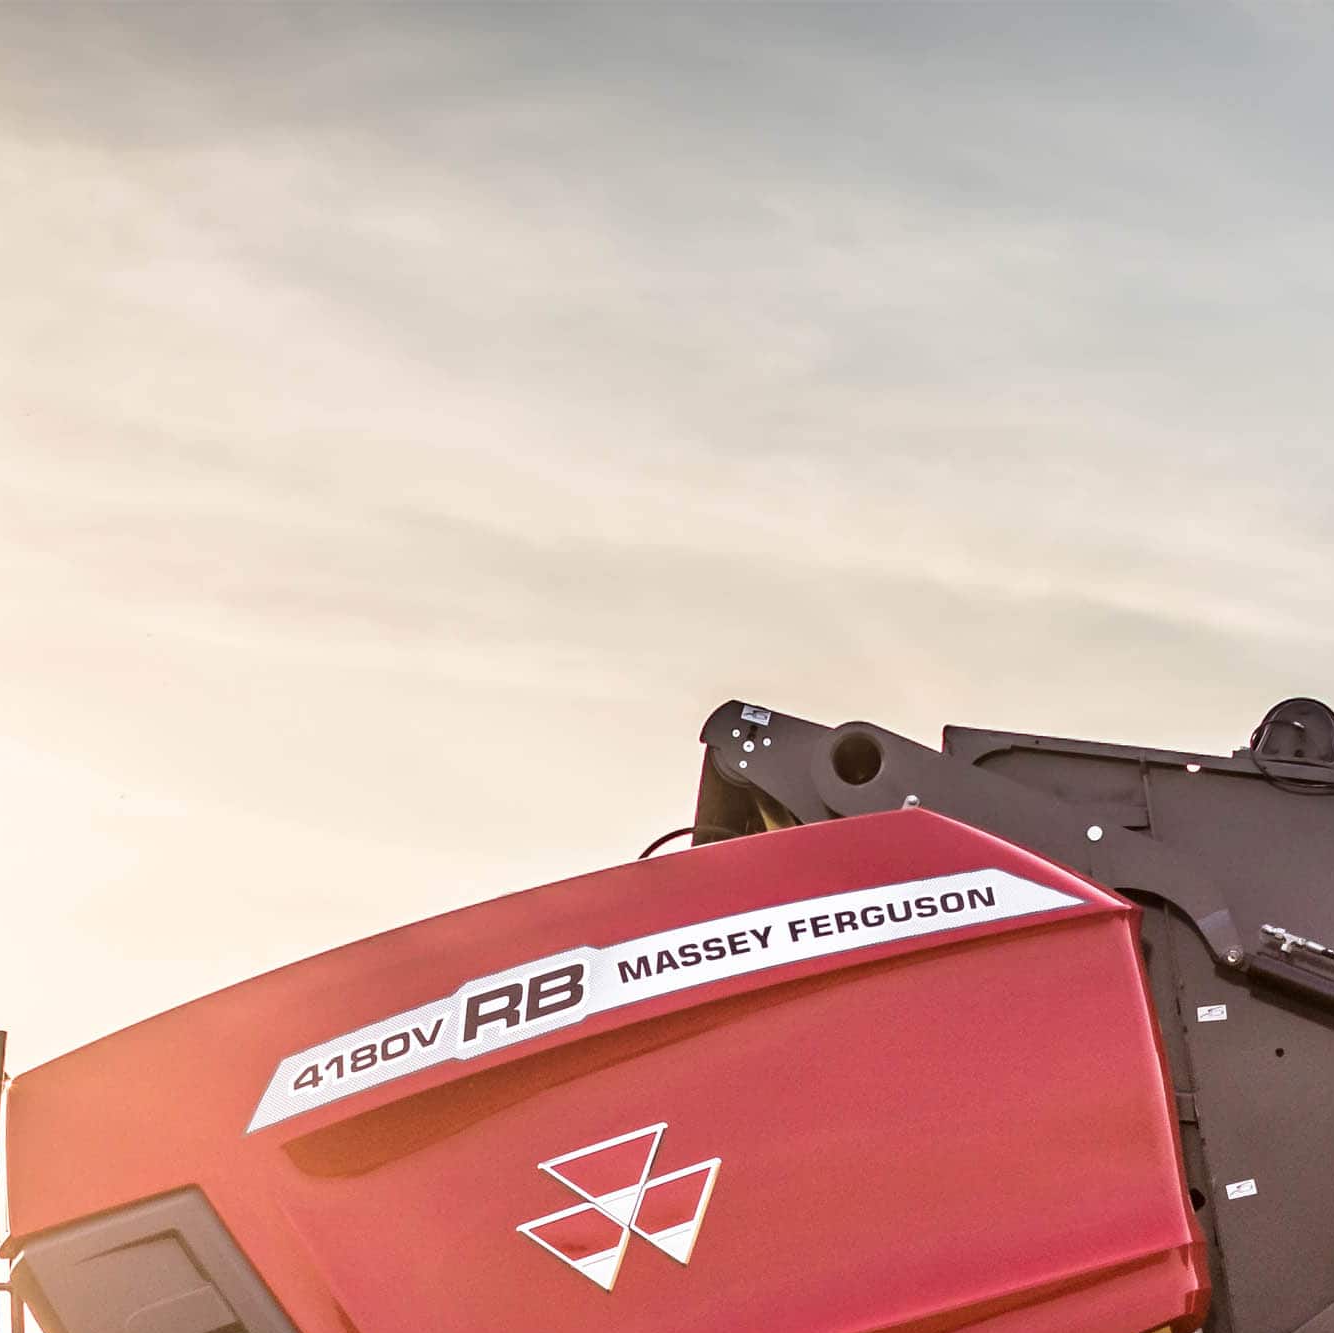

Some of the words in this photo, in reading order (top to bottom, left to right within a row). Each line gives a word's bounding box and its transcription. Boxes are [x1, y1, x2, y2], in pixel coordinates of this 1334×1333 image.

[293, 1018, 444, 1091] 4180V
[463, 963, 585, 1043] RB
[617, 925, 773, 984] MASSEY
[787, 886, 997, 943] FERGUSON
